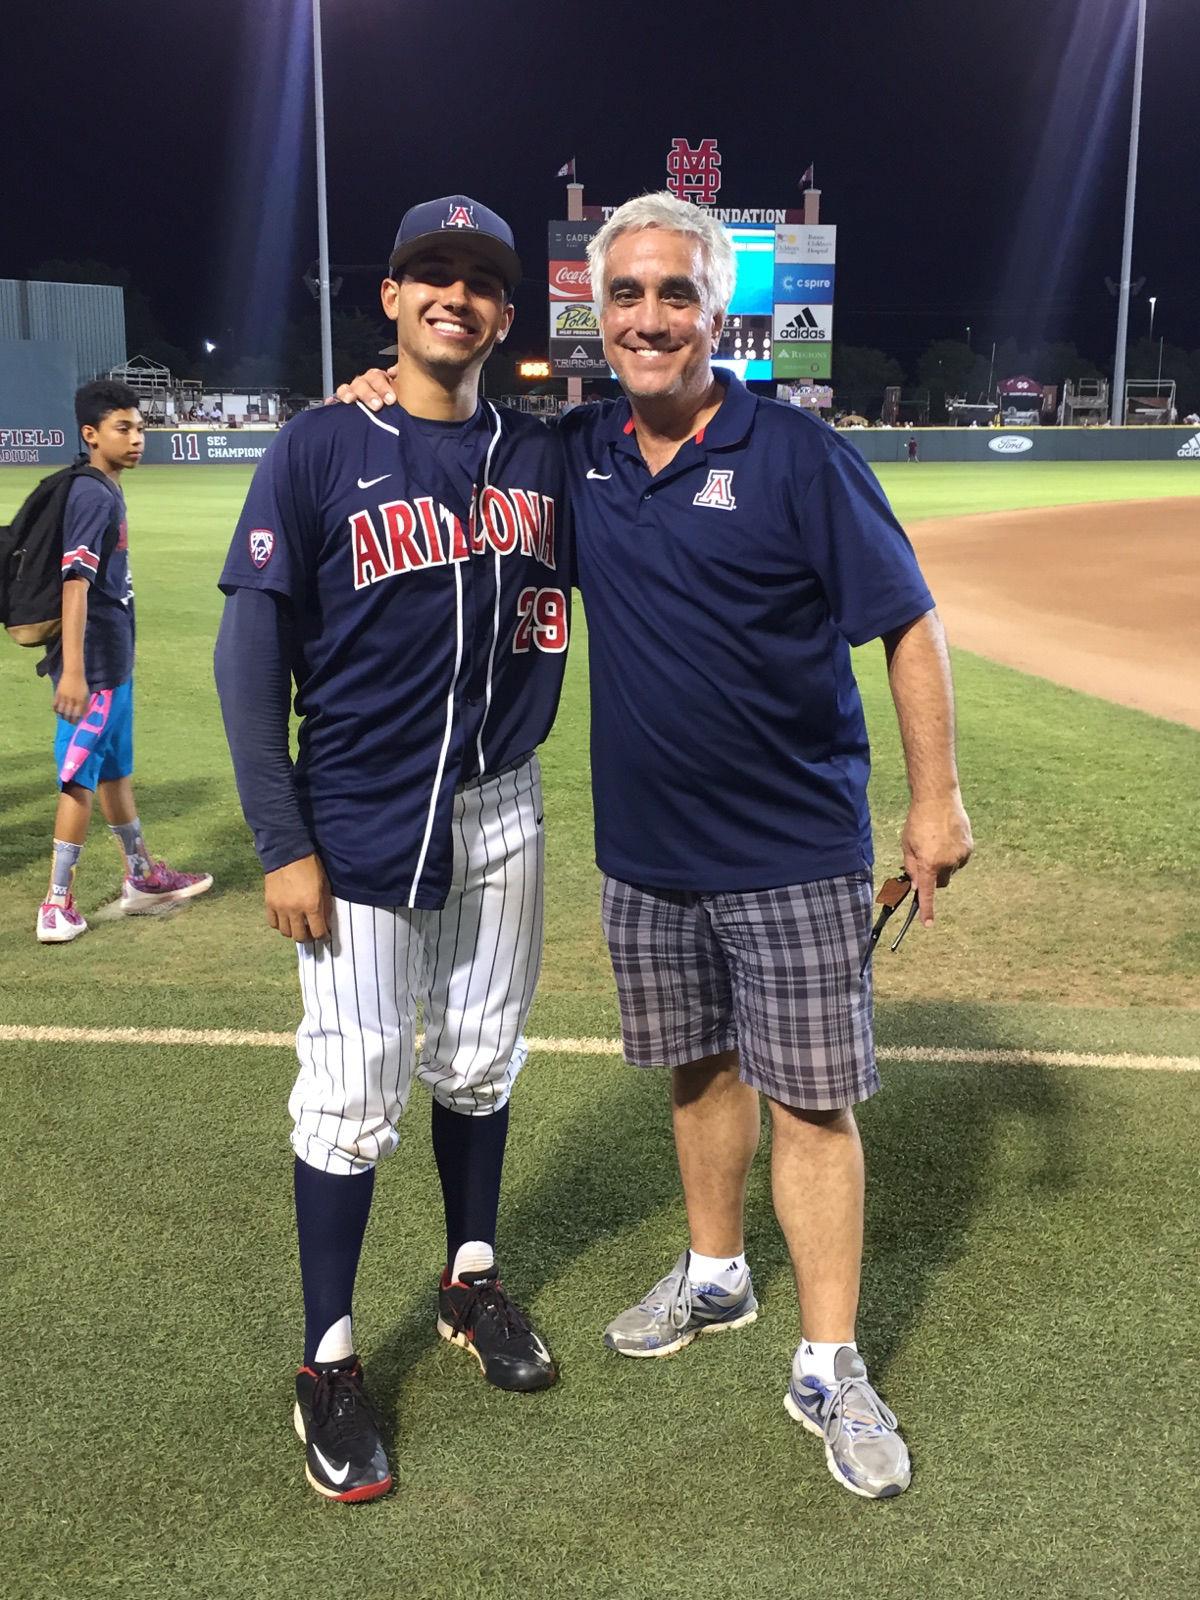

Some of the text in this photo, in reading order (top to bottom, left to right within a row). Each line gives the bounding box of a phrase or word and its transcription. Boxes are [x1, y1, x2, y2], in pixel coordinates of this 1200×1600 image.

[442, 203, 479, 230] A
[557, 308, 597, 328] Polk's
[780, 328, 826, 339] adidas
[554, 359, 606, 367] TRIANGLE
[0, 429, 65, 446] FIELD
[171, 433, 200, 460] 11
[207, 436, 227, 446] SEC
[692, 469, 735, 511] A
[348, 483, 556, 590] ARIZONA
[254, 546, 268, 561] 12
[512, 586, 569, 654] 29
